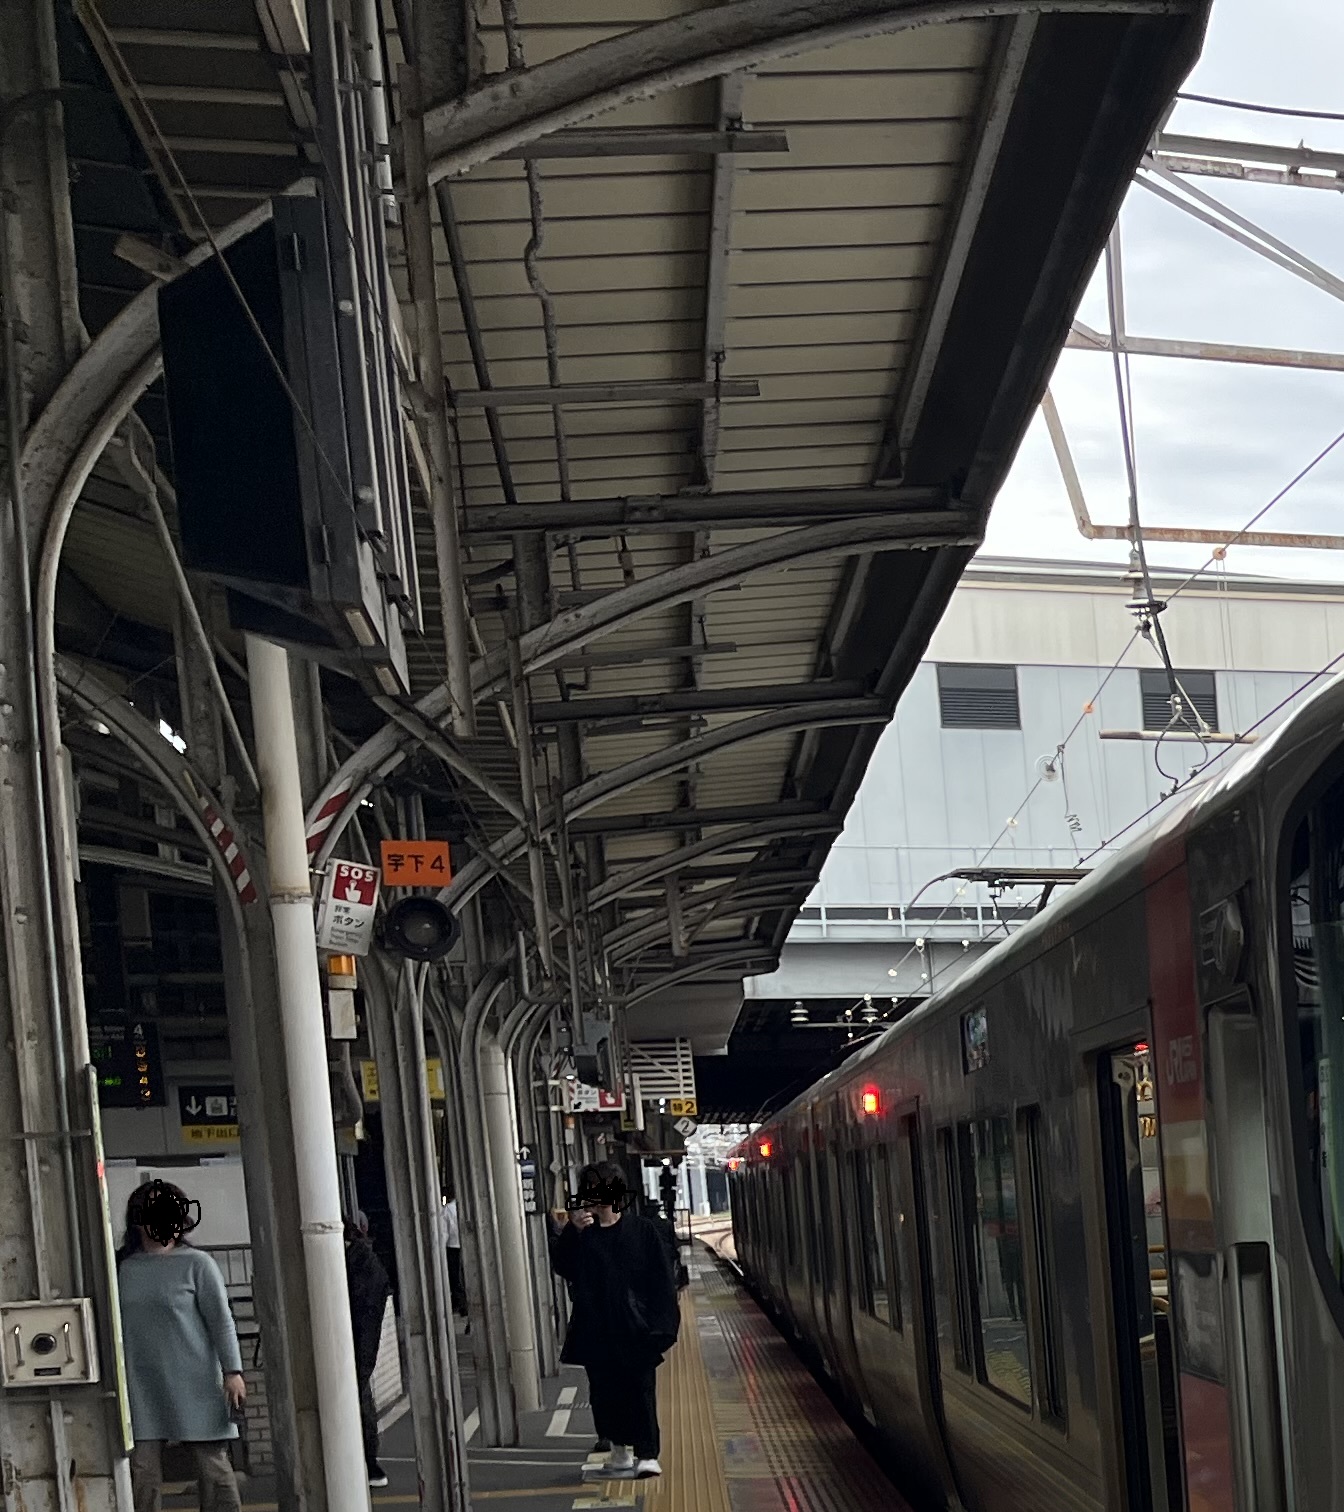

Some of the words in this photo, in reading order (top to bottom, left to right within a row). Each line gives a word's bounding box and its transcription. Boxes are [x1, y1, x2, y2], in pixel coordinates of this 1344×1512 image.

[339, 864, 375, 883] SOS
[333, 915, 365, 928] ボタン
